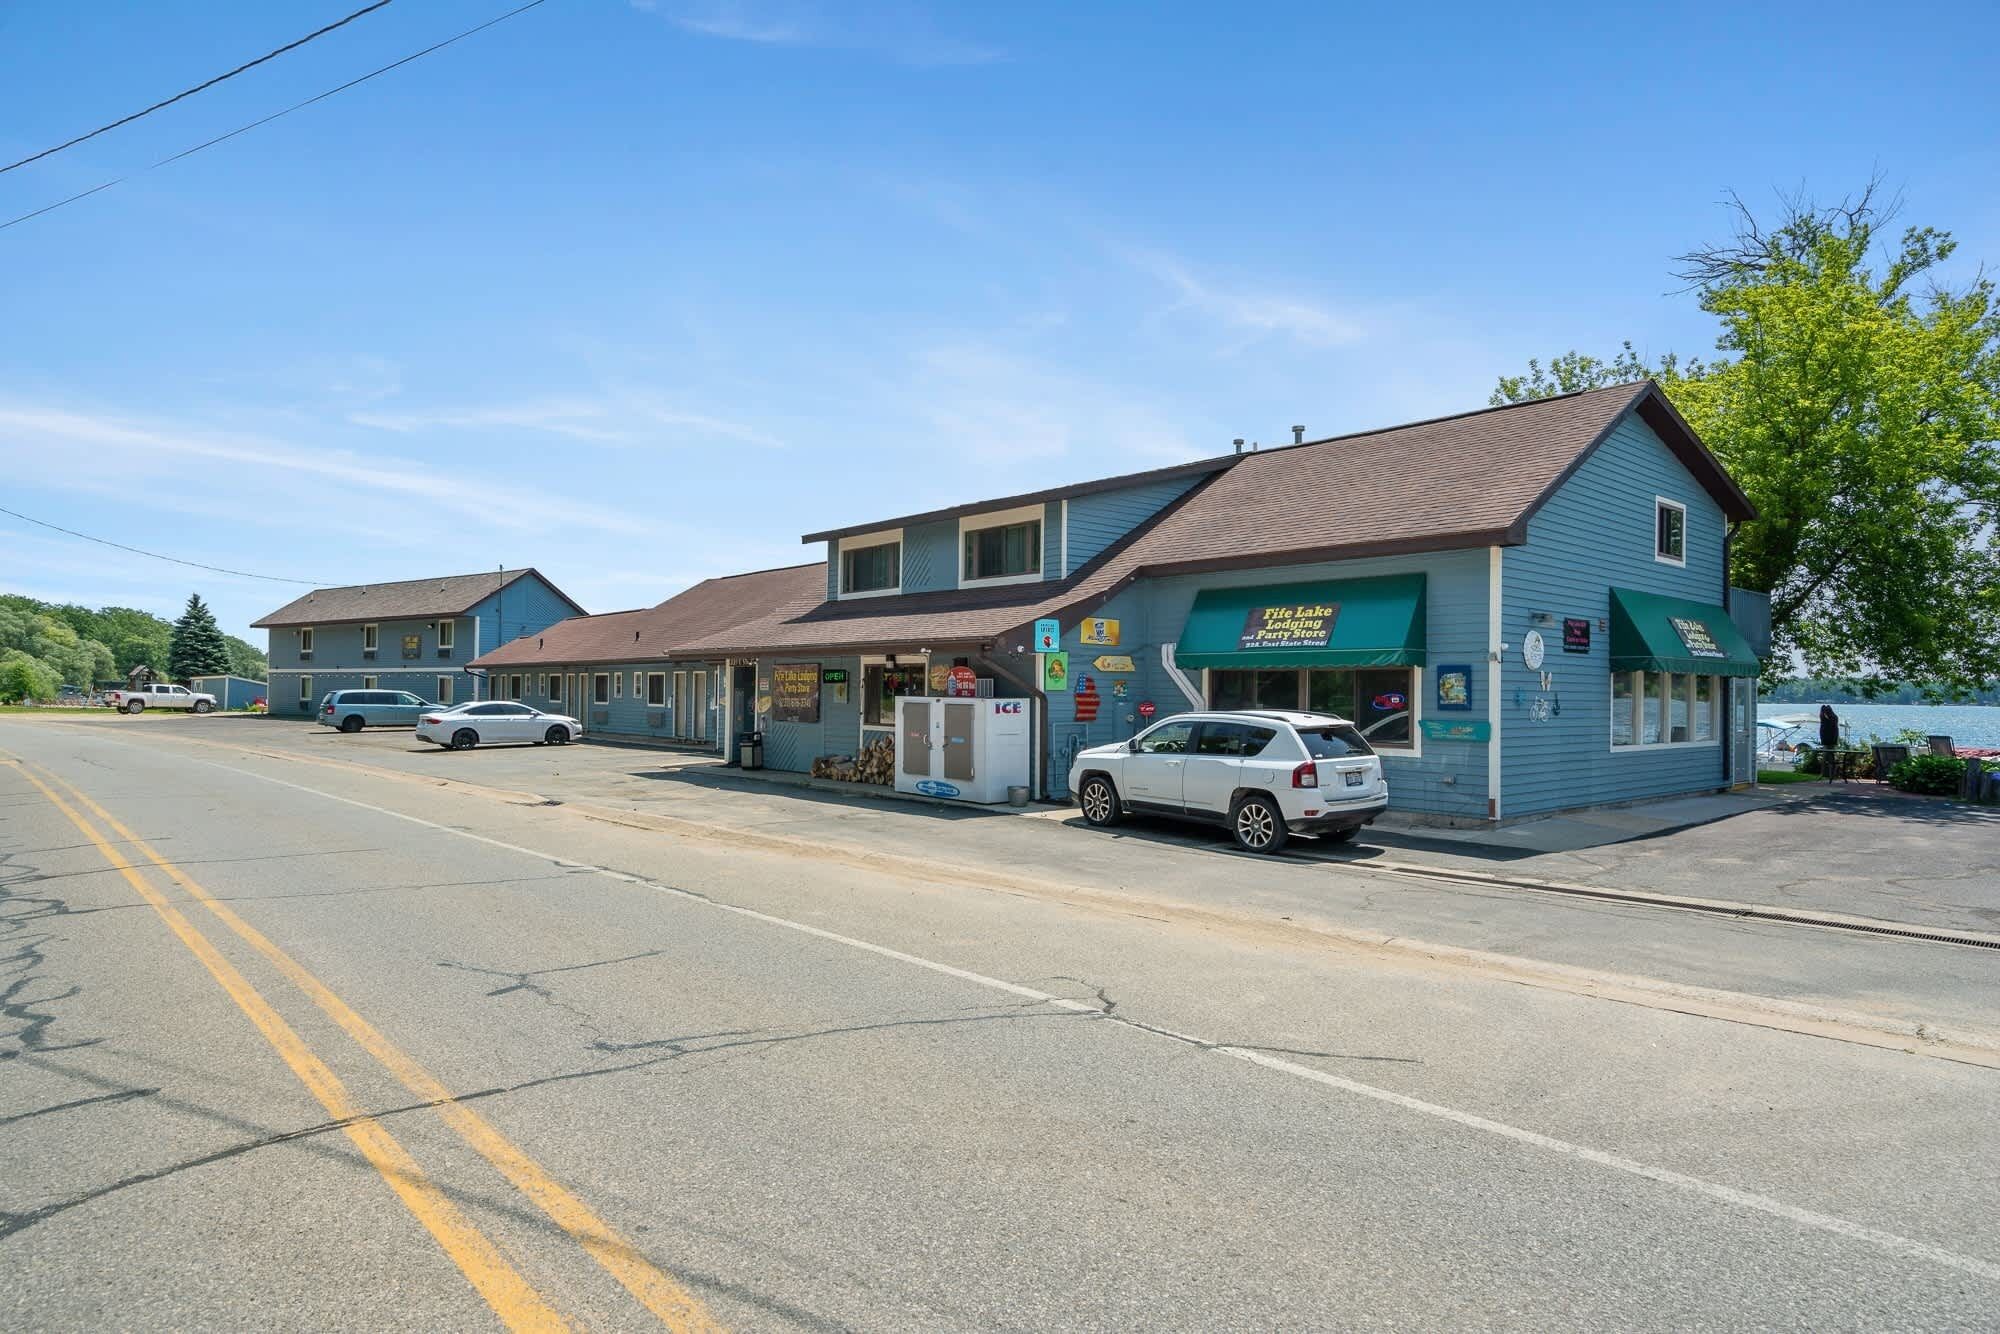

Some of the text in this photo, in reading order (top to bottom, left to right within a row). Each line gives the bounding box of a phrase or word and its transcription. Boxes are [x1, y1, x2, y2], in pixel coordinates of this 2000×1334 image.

[1263, 605, 1333, 619] Fife Lake
[1265, 618, 1323, 630] Lodging
[1256, 629, 1291, 640] Party
[1292, 628, 1326, 638] Store
[824, 672, 844, 681] OPEN
[994, 702, 1023, 715] ICE
